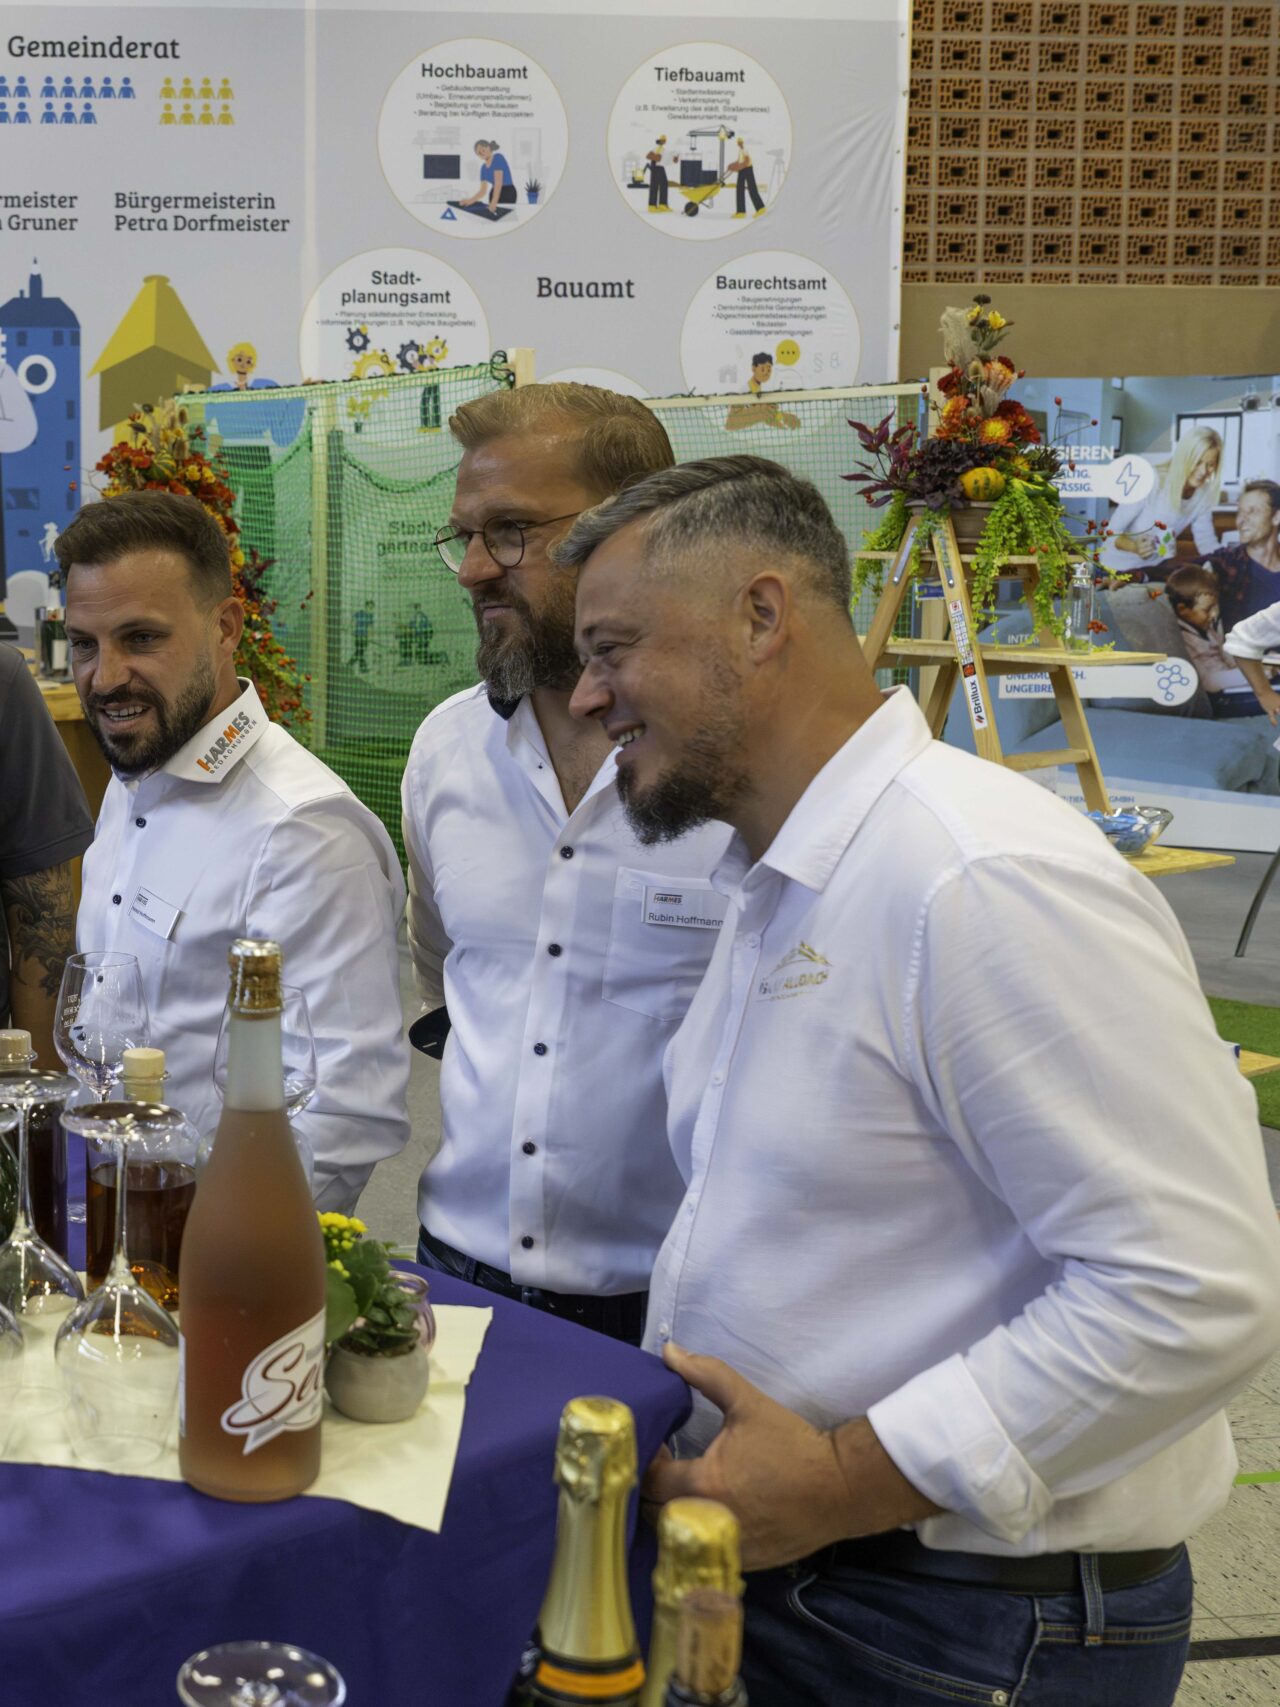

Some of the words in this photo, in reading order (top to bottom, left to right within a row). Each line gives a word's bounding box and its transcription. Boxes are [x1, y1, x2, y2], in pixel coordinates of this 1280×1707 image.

[8, 35, 180, 60] Gemeinderat
[422, 63, 528, 79] Hochbauamt
[654, 67, 746, 82] Tiefbauamt
[114, 191, 276, 213] Bürgermeisterin
[8, 214, 78, 231] Gruner
[114, 214, 168, 232] Petra
[173, 214, 290, 232] Dorfmeister
[371, 270, 422, 285] Stadt-
[716, 275, 827, 290] Baurechtsamt
[536, 277, 635, 298] Bauamt
[341, 289, 451, 307] planungsamt
[1005, 683, 1053, 694] UNGEBRE
[970, 681, 983, 714] Brillux
[196, 711, 250, 772] HARMES
[676, 915, 724, 926] Hoffmann
